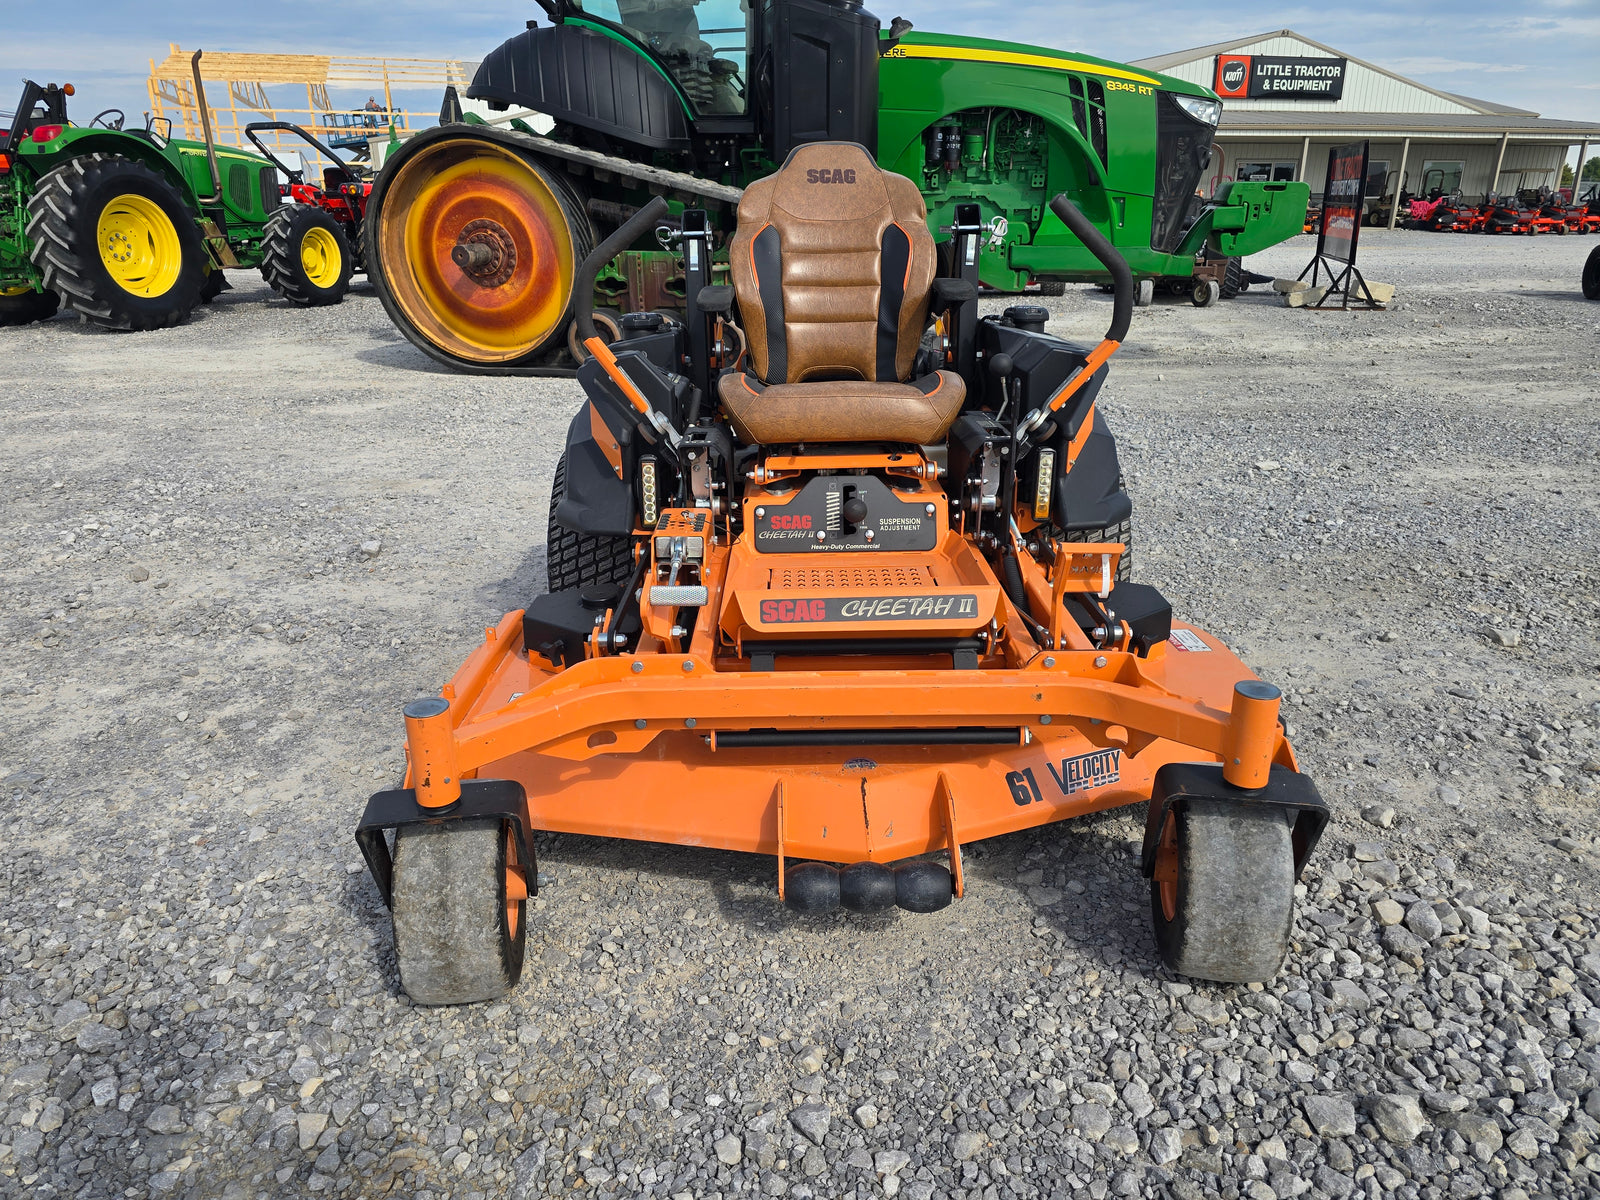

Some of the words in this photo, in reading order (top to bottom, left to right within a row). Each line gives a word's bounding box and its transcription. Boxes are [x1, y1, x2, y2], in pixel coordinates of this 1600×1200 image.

[1257, 65, 1292, 76] LITTLE
[1295, 66, 1341, 77] TRACTOR
[1106, 80, 1136, 93] 8345
[1138, 85, 1153, 96] RT
[1263, 80, 1270, 90] &
[1273, 80, 1332, 91] EQUIPMENT
[806, 169, 856, 184] SCAG
[771, 515, 812, 529] SCAG
[758, 530, 807, 539] CHEETAH
[762, 600, 826, 622] SCAG
[841, 597, 955, 617] CHEETAH
[958, 598, 974, 613] II
[1005, 767, 1043, 806] 61
[1046, 747, 1121, 795] VELOCITY
[1069, 772, 1120, 794] PLUS
